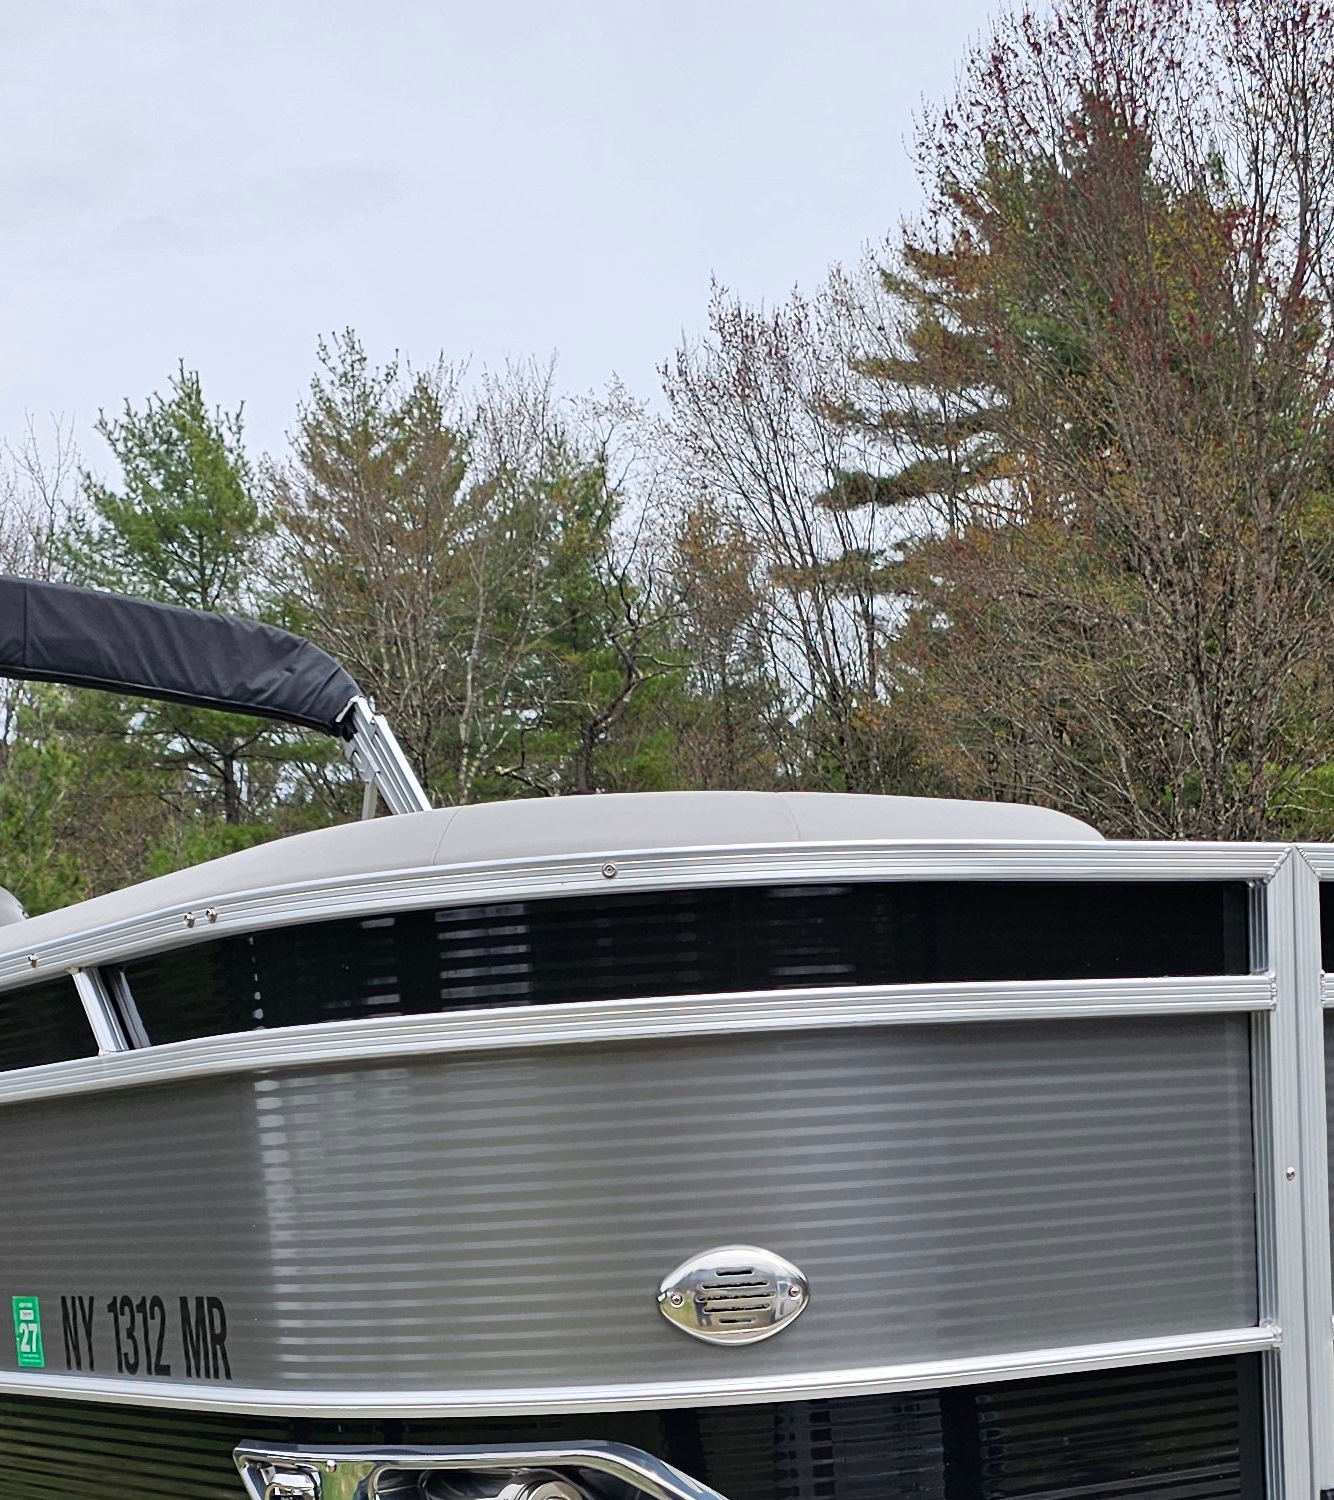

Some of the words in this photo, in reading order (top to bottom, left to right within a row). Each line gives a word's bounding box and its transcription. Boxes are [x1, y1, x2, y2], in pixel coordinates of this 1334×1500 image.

[19, 1322, 38, 1352] 27
[60, 1296, 95, 1371] NY
[107, 1295, 171, 1376] 1312
[179, 1296, 232, 1380] MR
